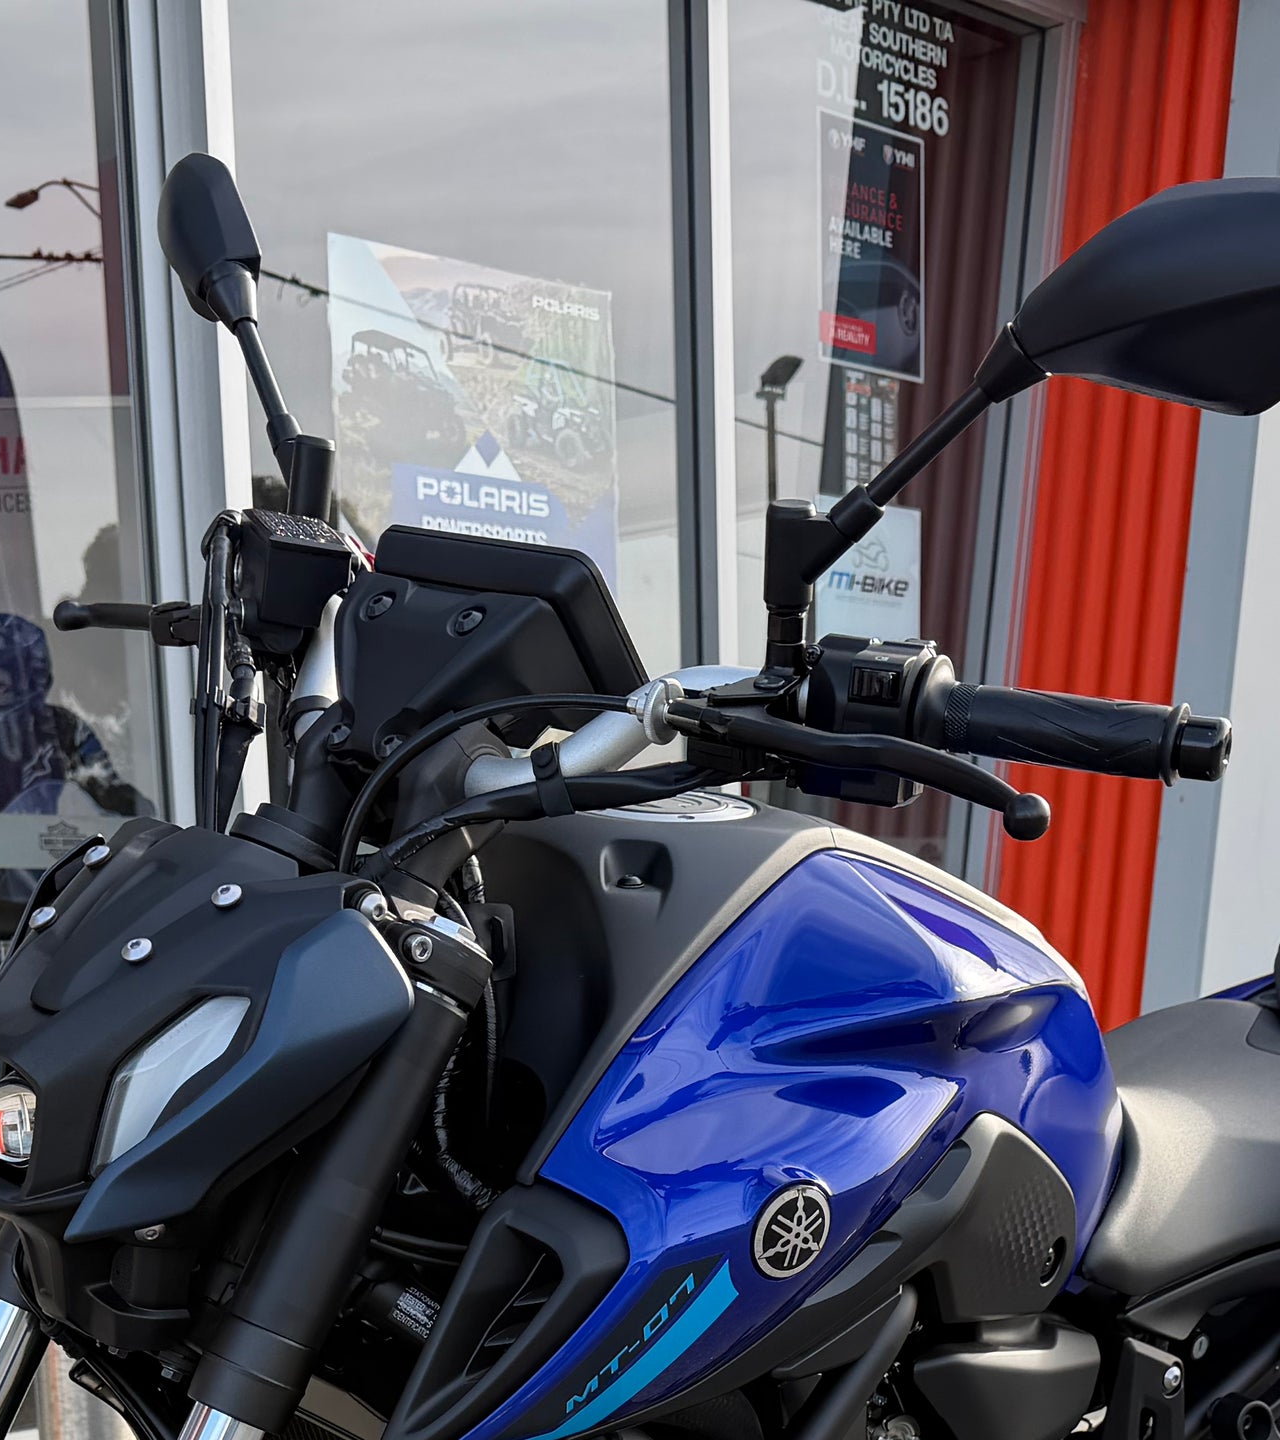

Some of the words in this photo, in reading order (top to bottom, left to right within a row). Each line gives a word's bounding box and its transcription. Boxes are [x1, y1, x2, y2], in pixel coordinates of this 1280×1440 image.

[872, 0, 901, 23] PTY
[905, 8, 929, 33] LTD
[869, 23, 947, 68] SOUTHERN
[877, 79, 949, 137] 15186
[829, 216, 893, 248] AVAILABLE
[829, 236, 861, 259] HERE
[532, 295, 600, 321] POLARIS
[417, 476, 550, 518] POLARIS
[566, 1272, 695, 1414] MT-07
